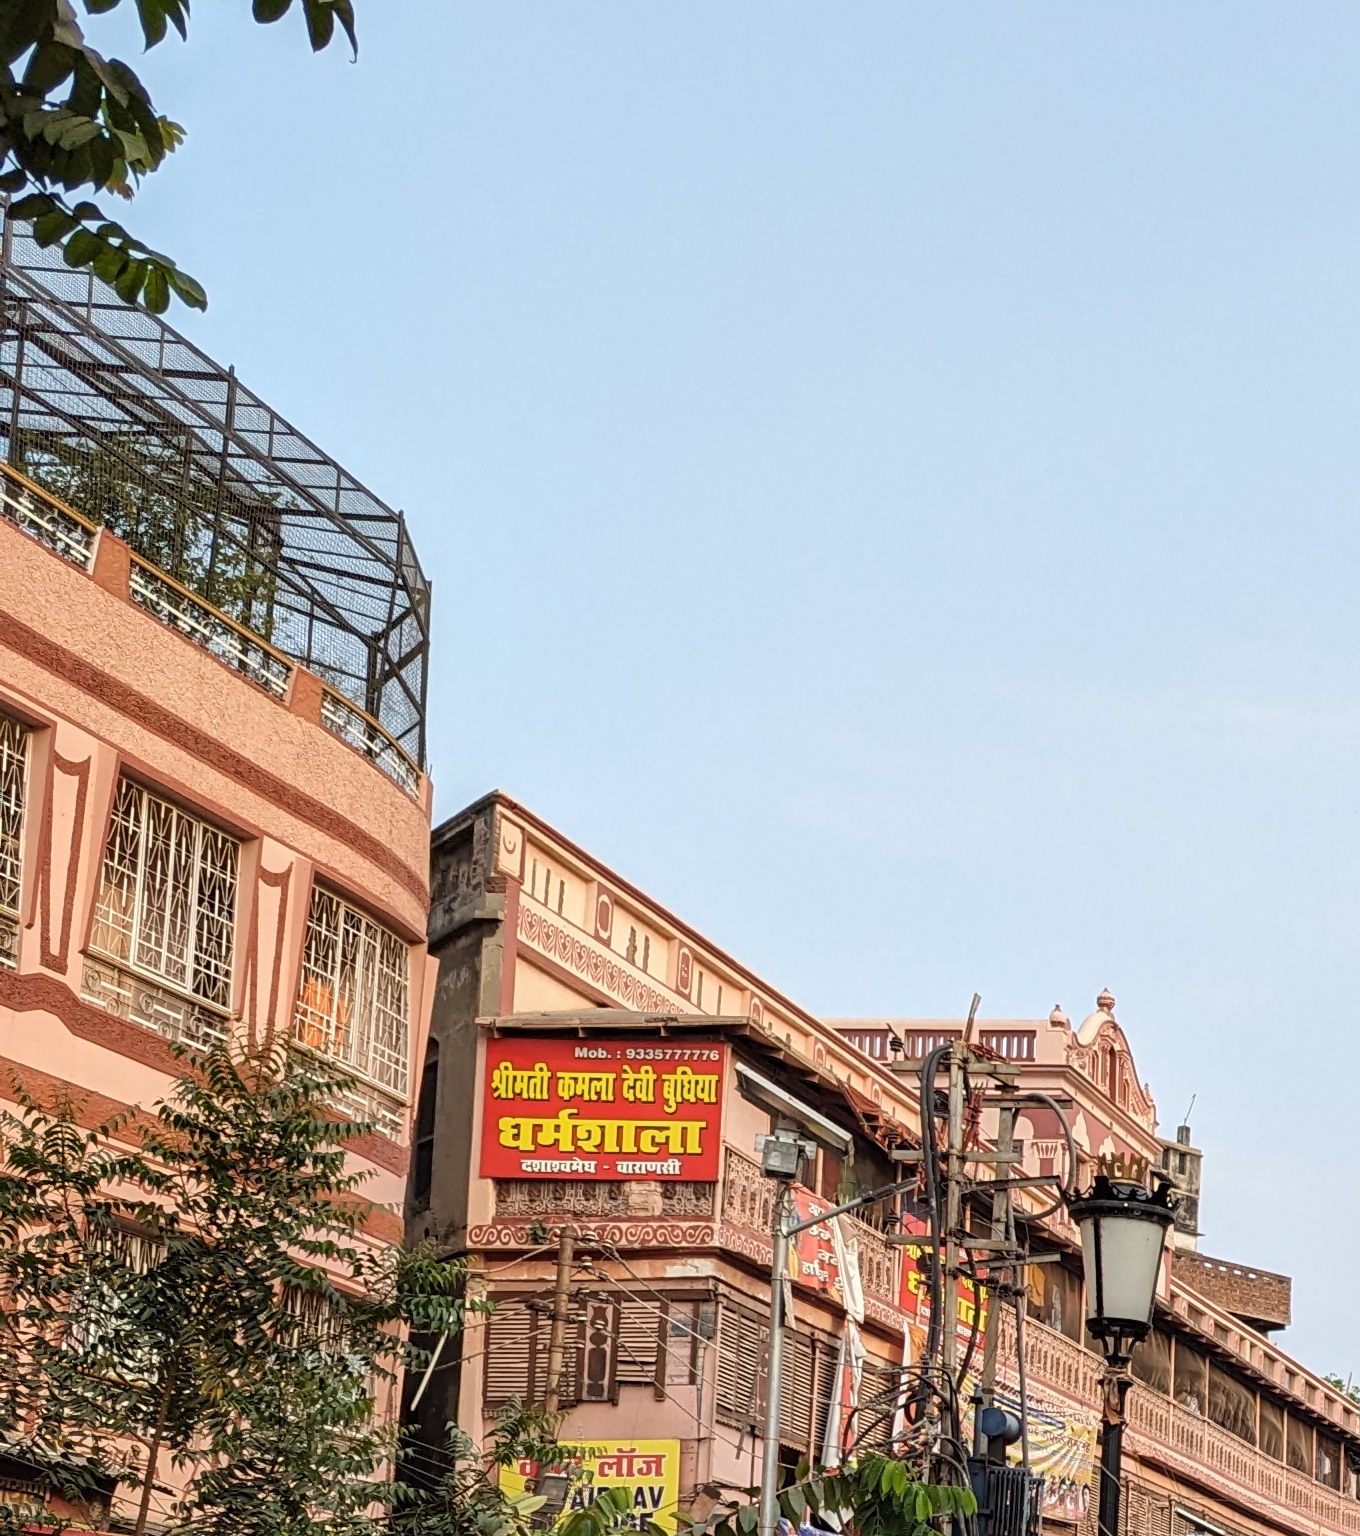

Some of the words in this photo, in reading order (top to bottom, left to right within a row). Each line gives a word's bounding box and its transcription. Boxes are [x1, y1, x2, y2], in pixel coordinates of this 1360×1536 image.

[574, 1046, 612, 1060] Mob.
[626, 1048, 719, 1061] 9335777776
[491, 1062, 552, 1100] श्रीमती
[556, 1071, 616, 1101] कमला
[622, 1065, 656, 1102] देवी
[498, 1108, 707, 1154] धर्मशाला
[615, 1158, 682, 1175] वाराणसी
[597, 1448, 667, 1478] लॉज
